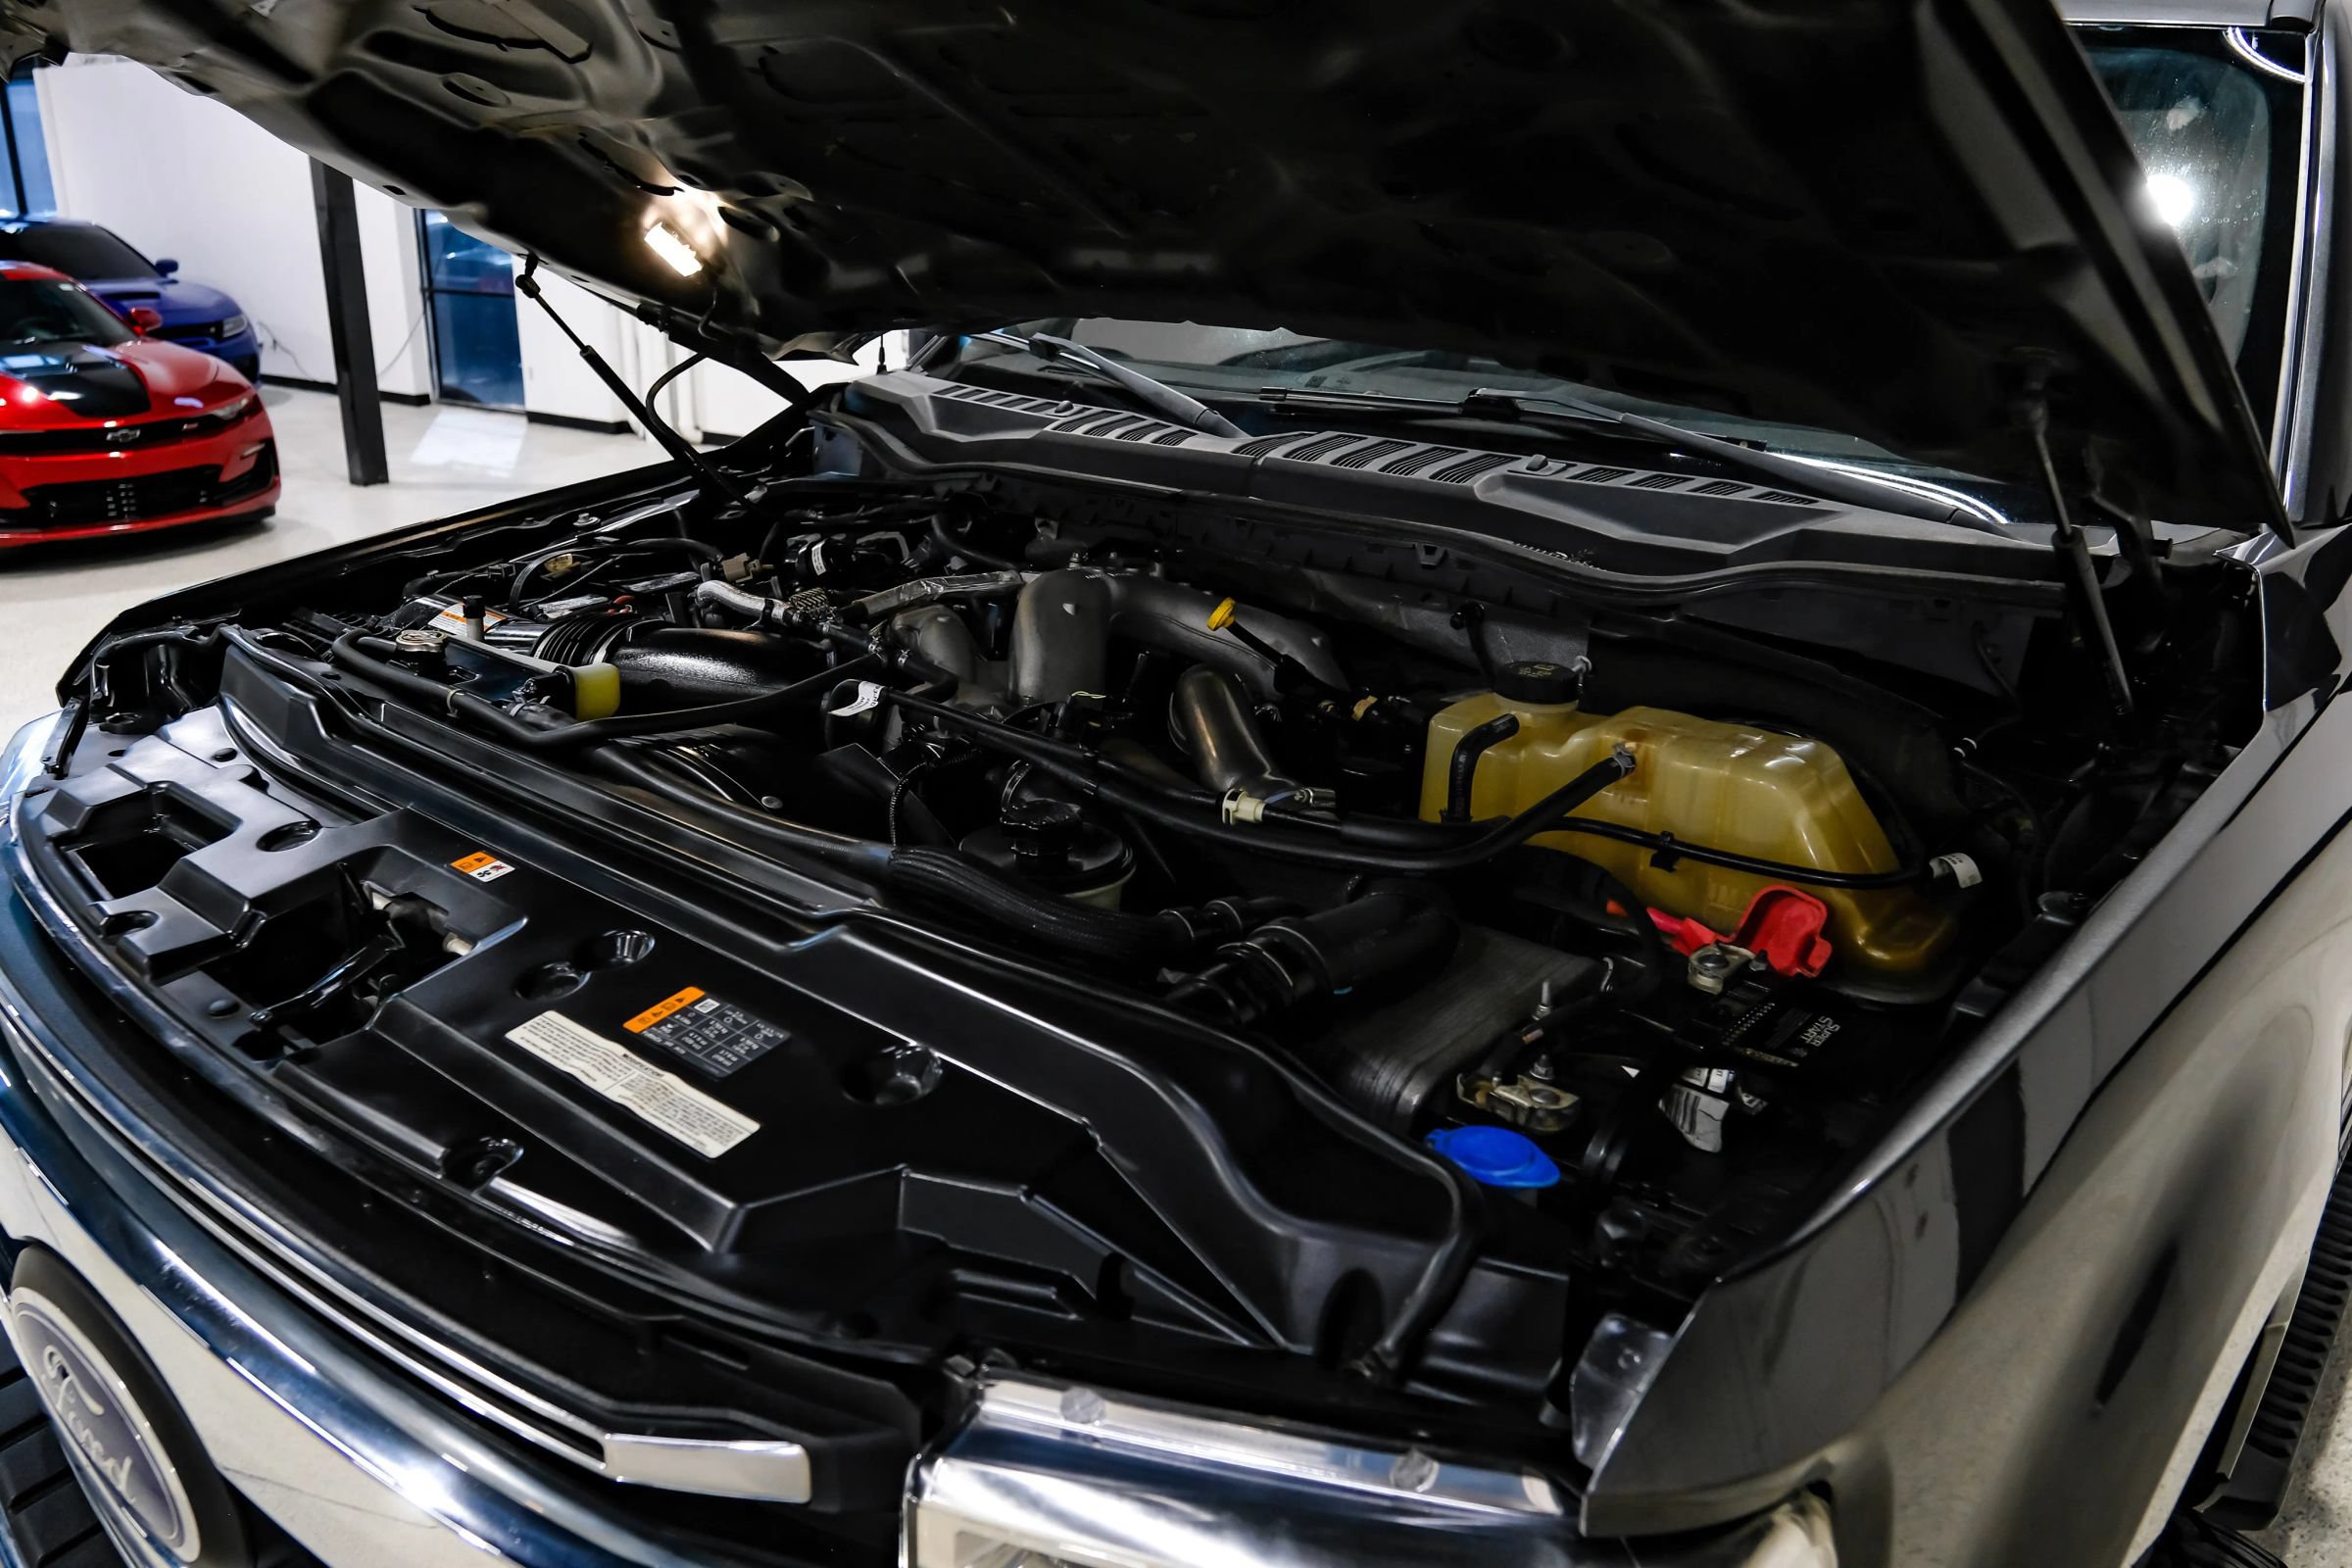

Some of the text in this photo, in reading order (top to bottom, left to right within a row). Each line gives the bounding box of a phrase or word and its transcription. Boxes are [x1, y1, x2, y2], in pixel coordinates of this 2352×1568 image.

[1800, 1015, 1833, 1043] START
[1811, 1024, 1840, 1047] SUPER
[42, 1345, 136, 1503] Ford
